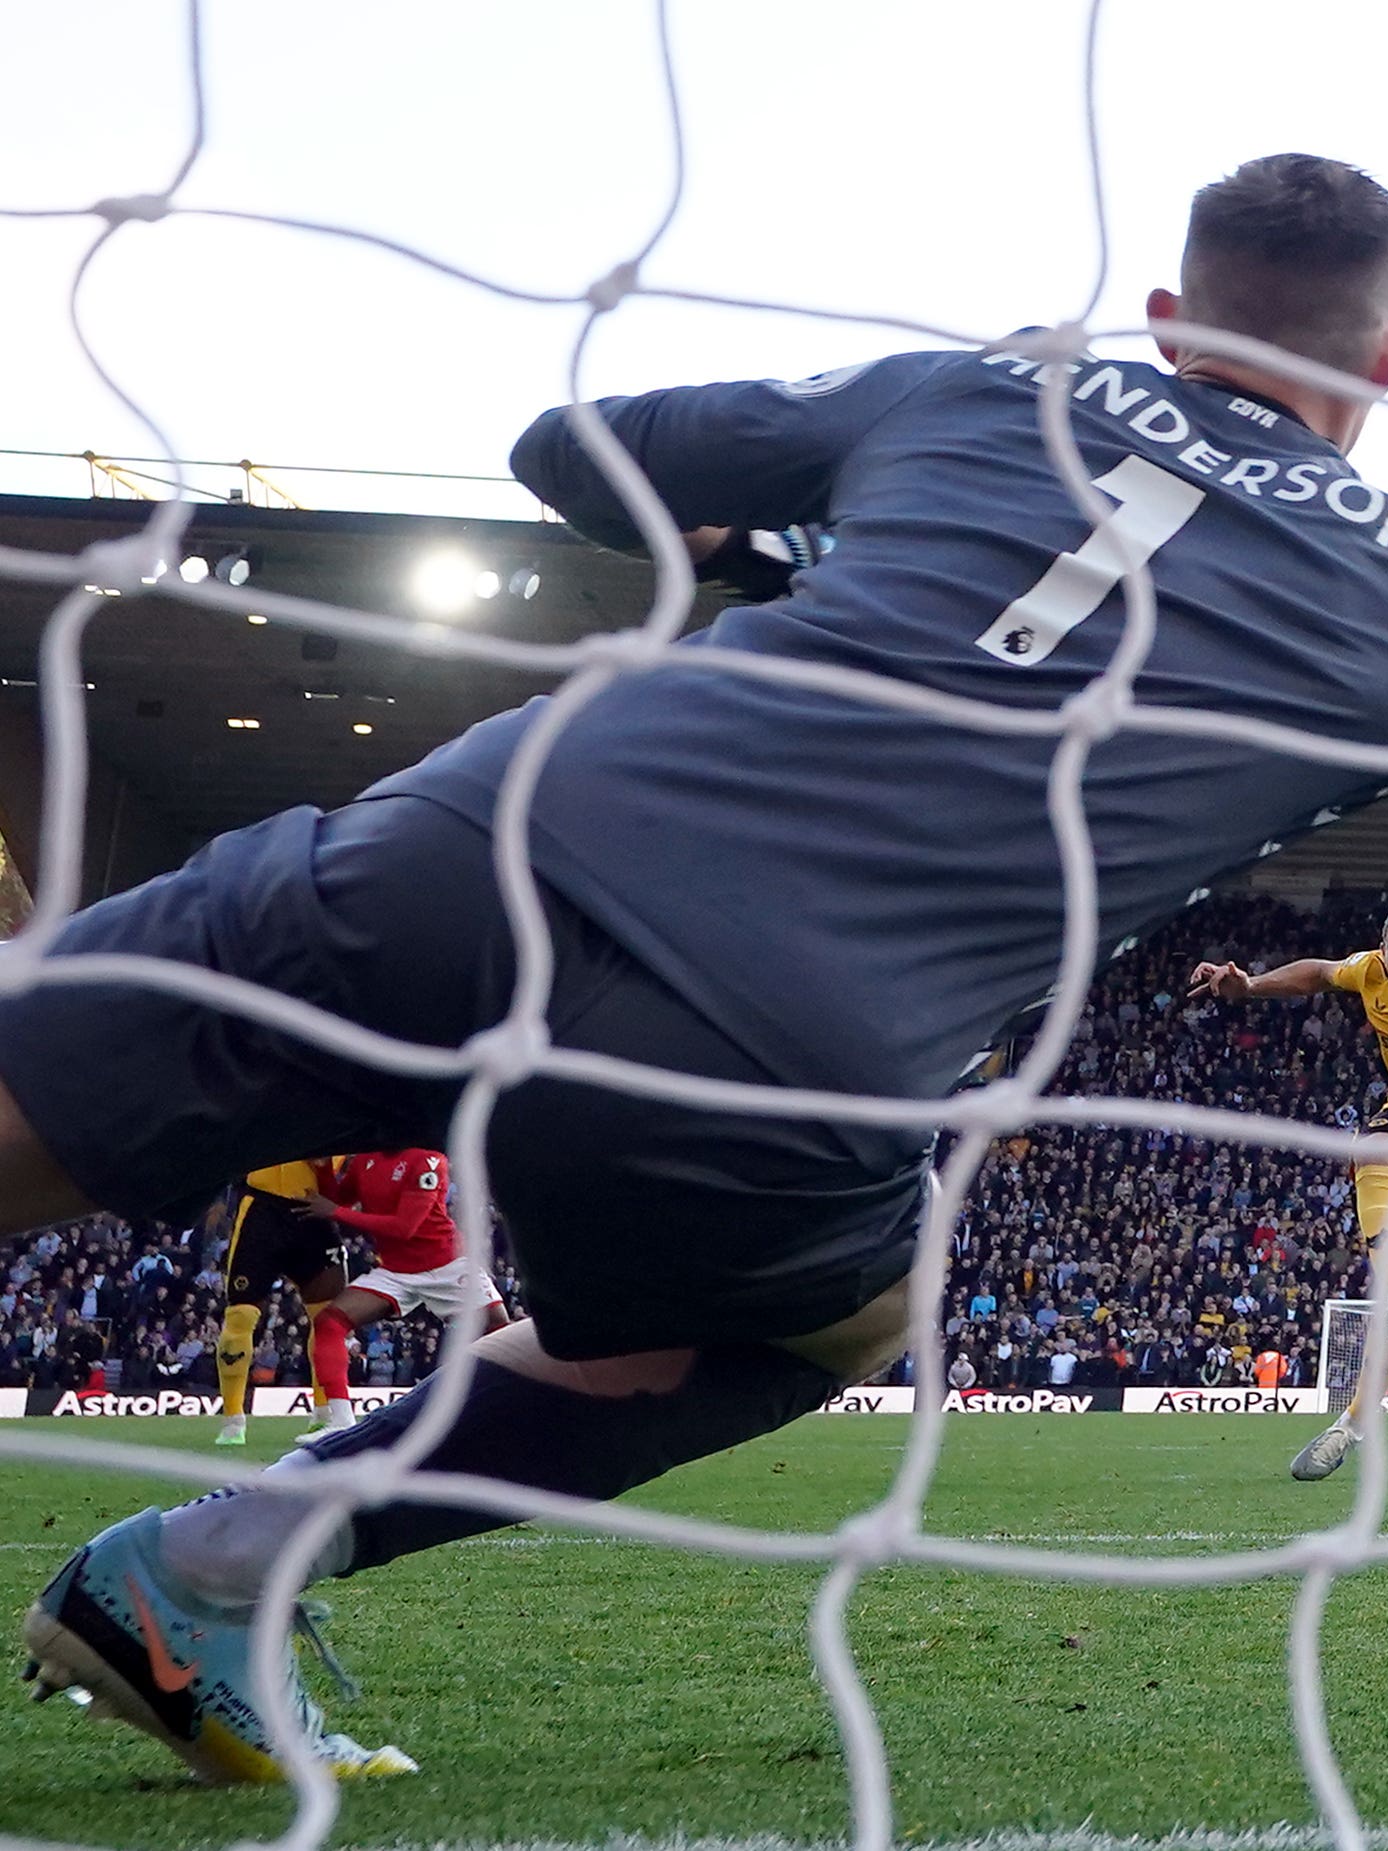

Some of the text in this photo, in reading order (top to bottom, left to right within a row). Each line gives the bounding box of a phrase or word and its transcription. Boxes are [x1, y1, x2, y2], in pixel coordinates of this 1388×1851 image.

[975, 454, 1207, 666] 1
[52, 1390, 224, 1416] AstroPay
[940, 1389, 1094, 1413] AstroPay
[1155, 1391, 1300, 1412] AstroPay
